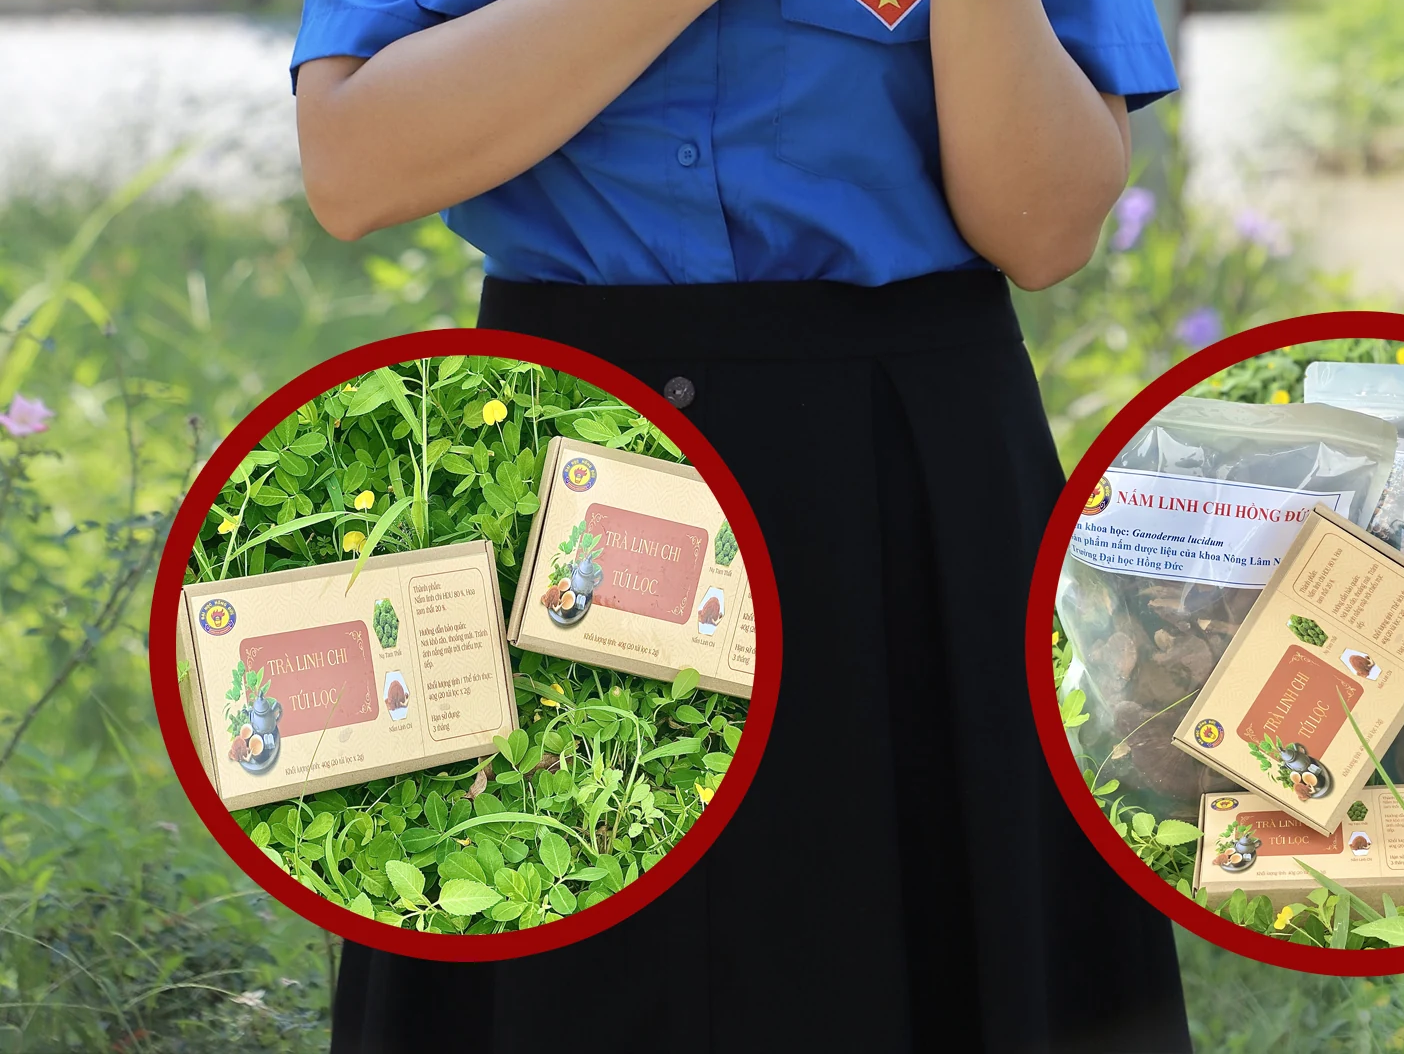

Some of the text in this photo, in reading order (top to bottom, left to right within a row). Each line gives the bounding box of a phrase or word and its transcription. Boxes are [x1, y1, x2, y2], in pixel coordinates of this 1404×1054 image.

[1117, 488, 1310, 522] NẤM LINH CHI HỒNG ĐỨ
[606, 530, 682, 563] TRÀ LINH CHI
[1085, 522, 1108, 534] khoa
[1110, 526, 1130, 537] học:
[1132, 528, 1186, 544] Ganoderma
[1187, 534, 1224, 548] lucidum
[1084, 536, 1109, 548] phẩm
[1111, 538, 1132, 550] nấm
[1160, 546, 1177, 558] liệu
[1179, 548, 1196, 558] của
[1198, 550, 1221, 562] khoa
[1222, 553, 1247, 566] Nông
[1250, 556, 1271, 566] Lâm
[1099, 552, 1115, 564] Đại
[1117, 554, 1134, 566] học
[1136, 556, 1162, 570] Hồng
[1164, 560, 1184, 571] Đức
[612, 569, 659, 596] TÚI LỌC
[266, 648, 348, 676] TRÀ LINH CHI
[289, 688, 338, 712] TÚI LỌC
[1263, 672, 1310, 734] TRÀ LINH CHI
[1298, 700, 1330, 740] TÚI LỌC
[1256, 818, 1276, 829] TRÀ
[1268, 834, 1310, 846] TÚI LỌC
